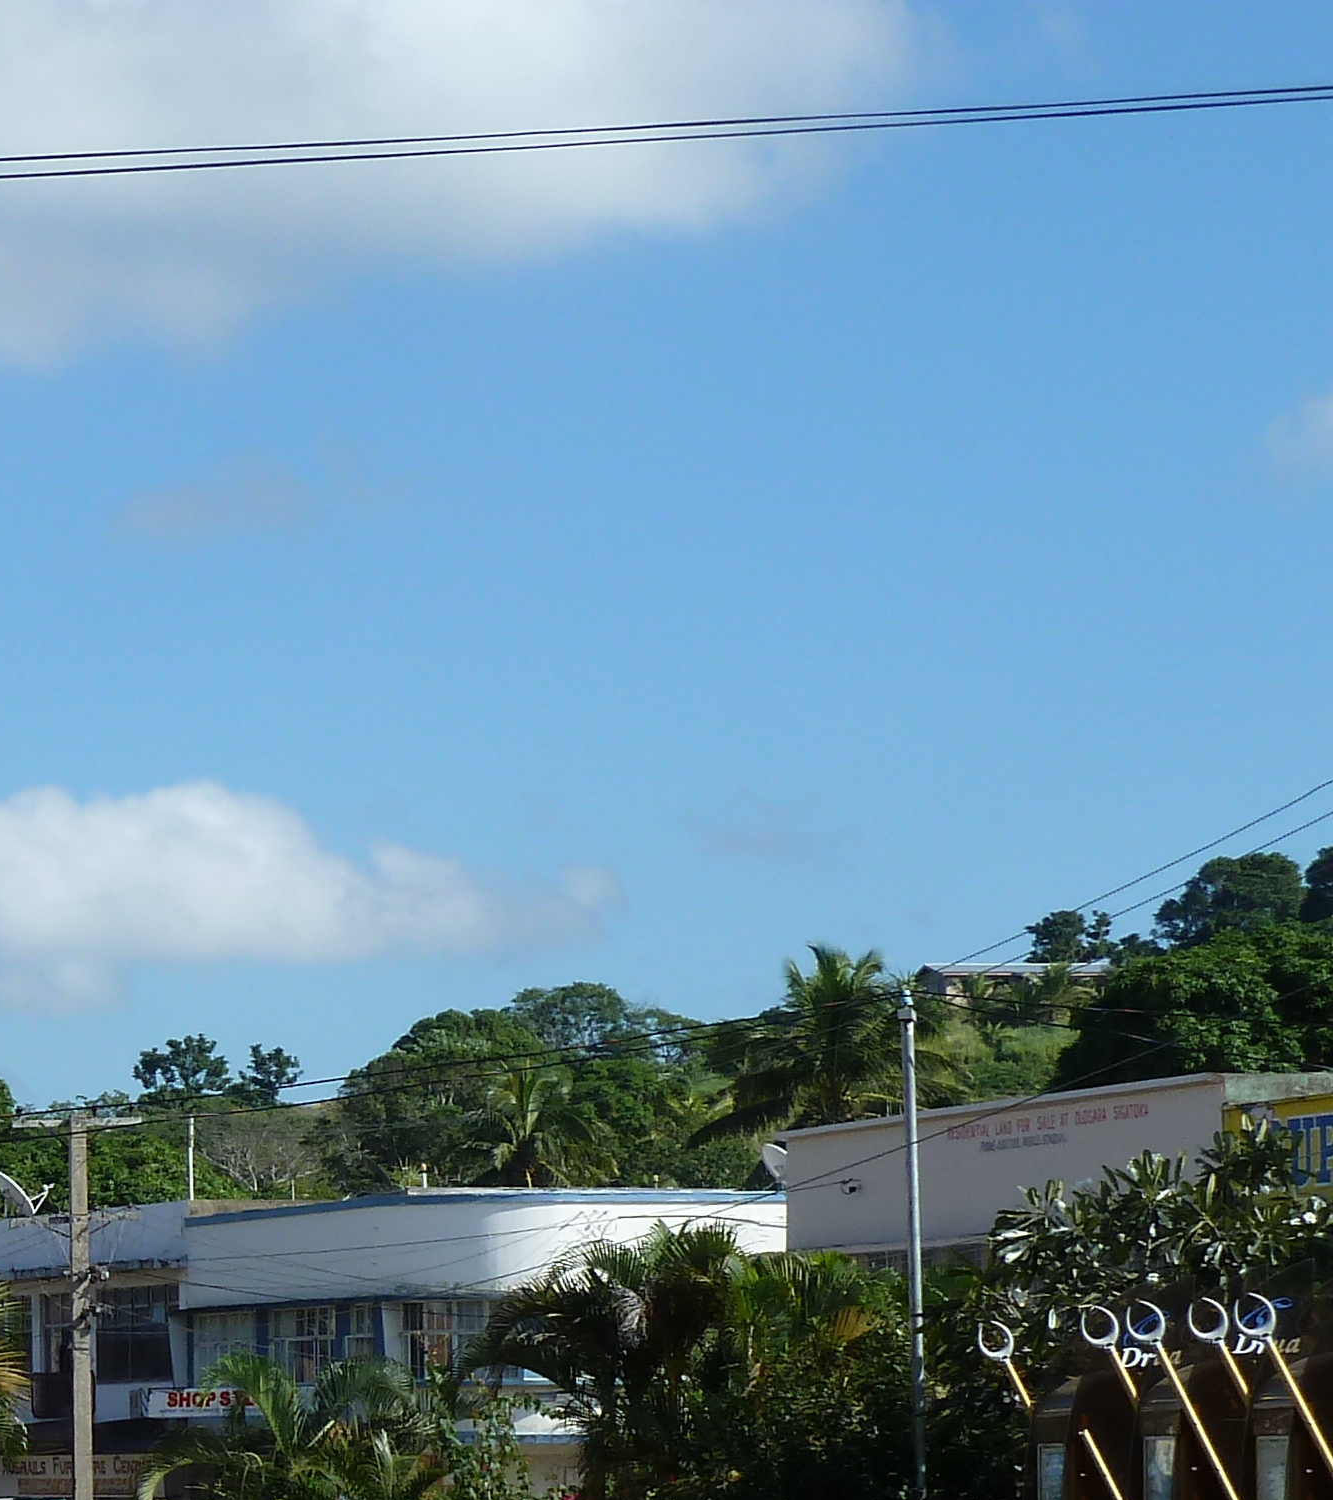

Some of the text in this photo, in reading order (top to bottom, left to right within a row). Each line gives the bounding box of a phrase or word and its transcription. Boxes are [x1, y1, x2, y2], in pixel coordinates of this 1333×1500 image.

[947, 1124, 990, 1140] RESIDENTIAL
[995, 1120, 1013, 1136] LAND
[1017, 1117, 1031, 1133] FOR
[1037, 1114, 1056, 1130] SALE
[1060, 1112, 1069, 1127] AT
[167, 1391, 216, 1407] SHOP
